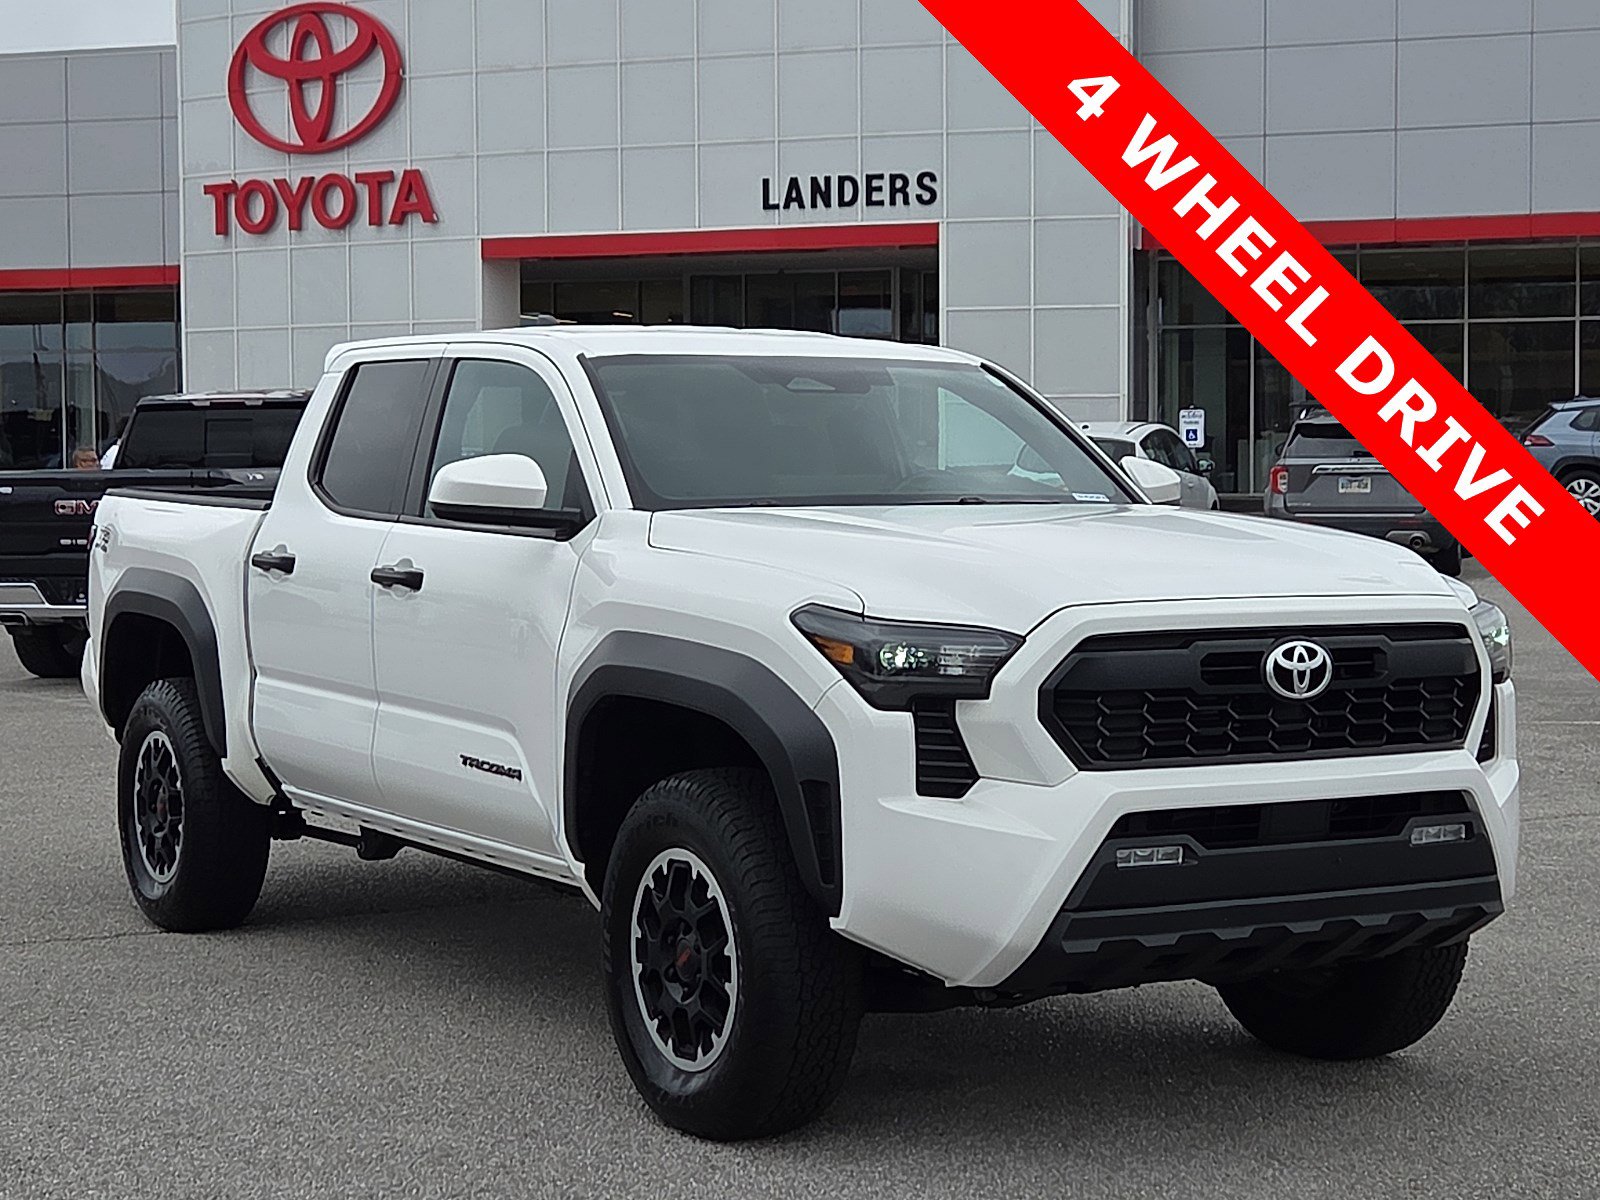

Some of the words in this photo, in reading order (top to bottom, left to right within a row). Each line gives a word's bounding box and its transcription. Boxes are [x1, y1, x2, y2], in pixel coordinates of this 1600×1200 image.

[204, 168, 437, 236] TOYOTA
[763, 172, 938, 211] LANDERS
[55, 499, 100, 515] GM
[460, 754, 522, 782] TACOMA
